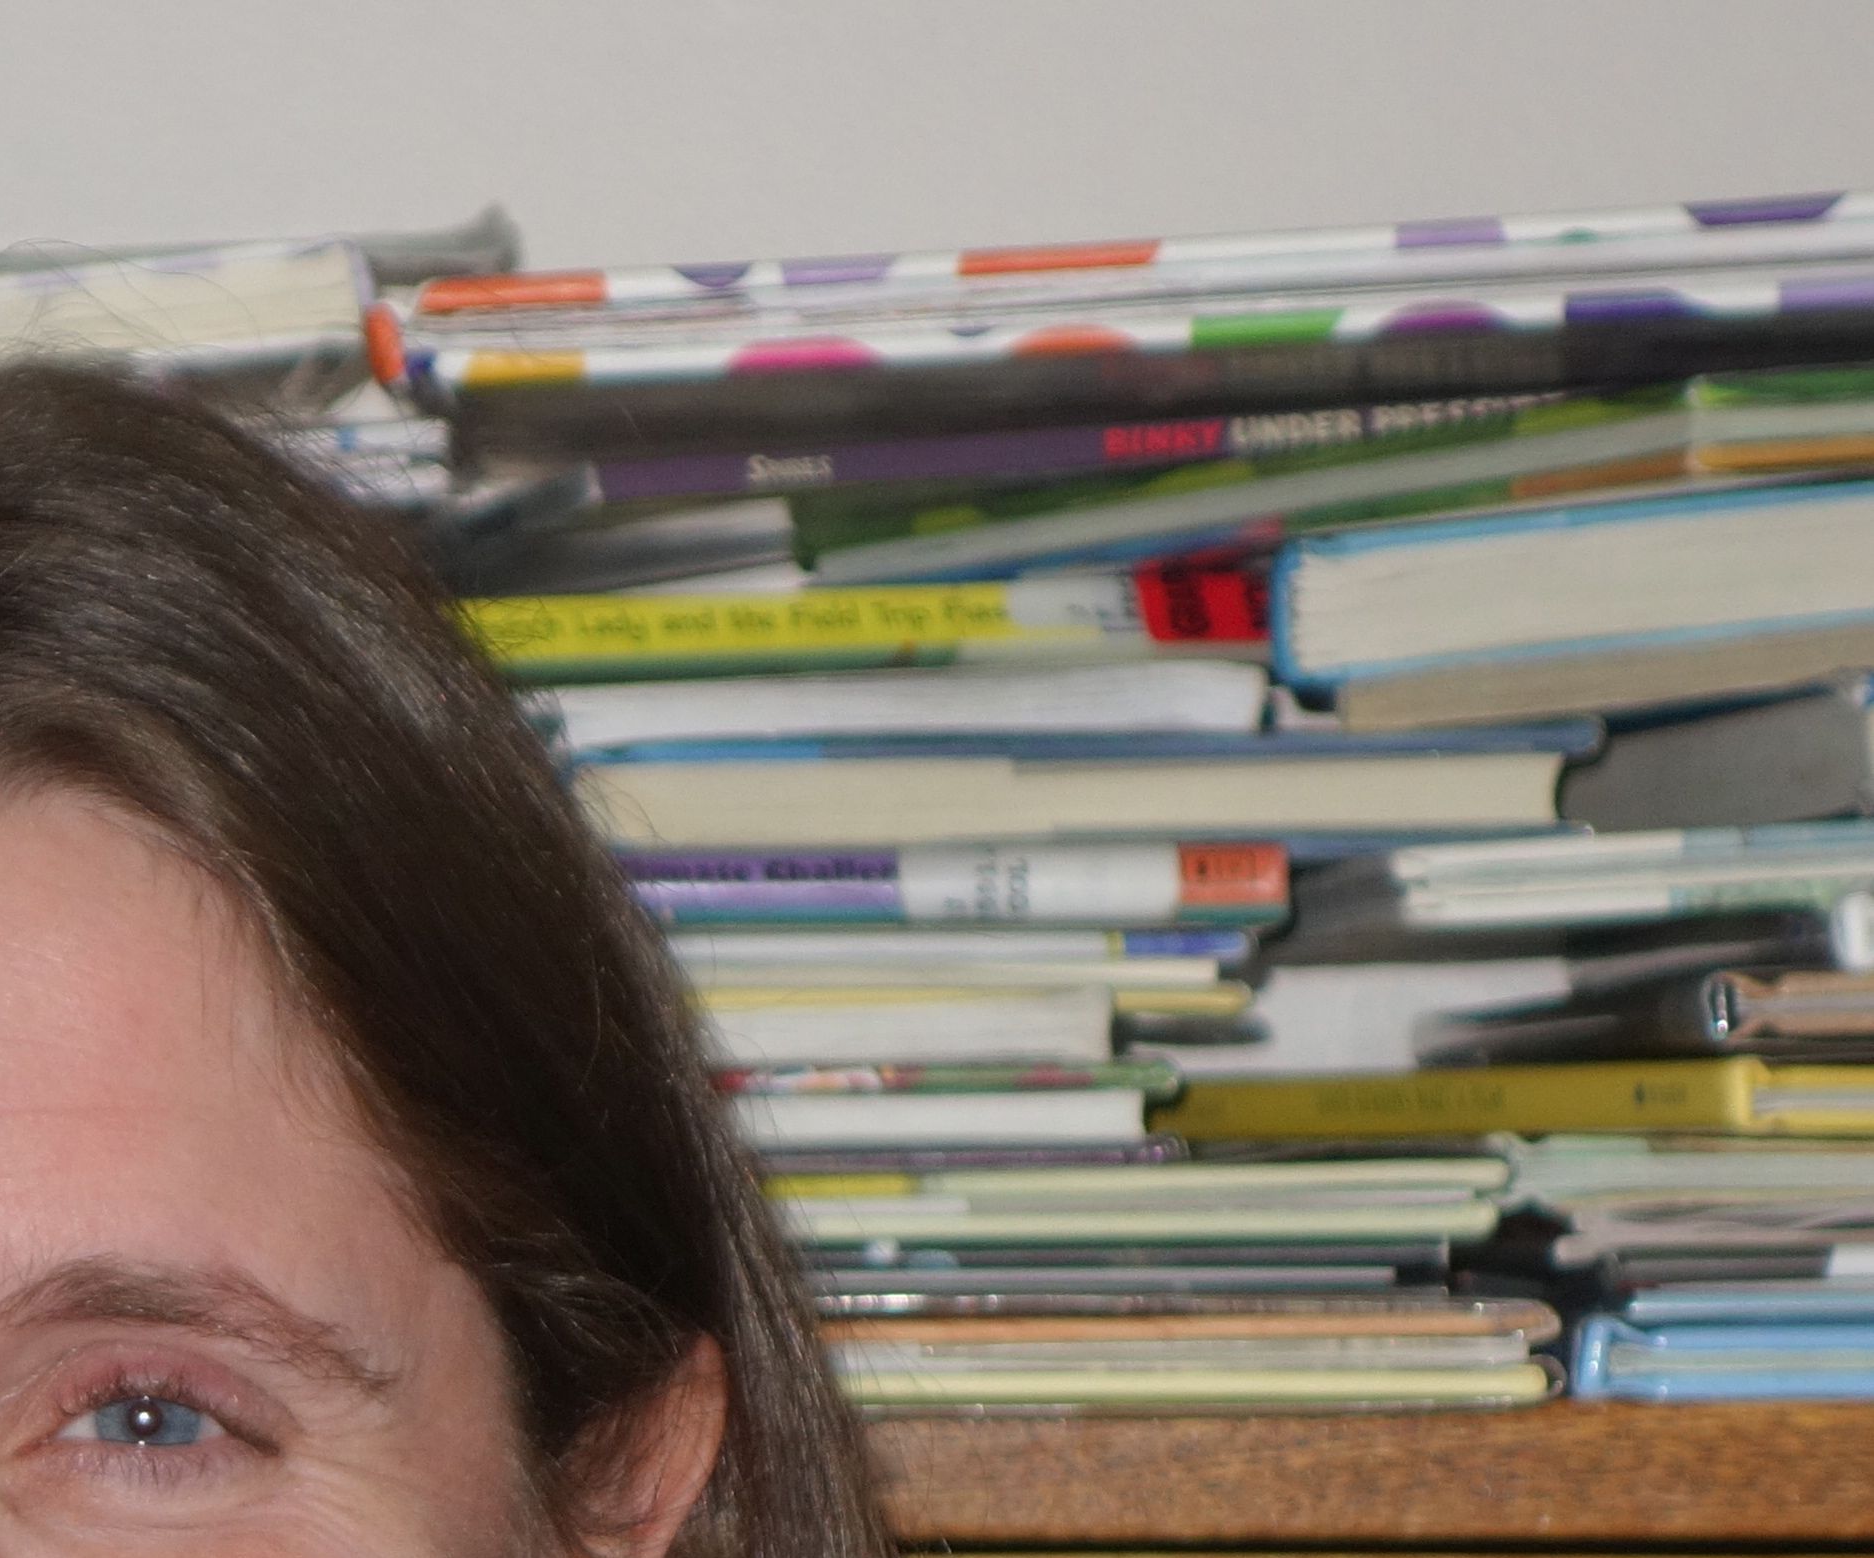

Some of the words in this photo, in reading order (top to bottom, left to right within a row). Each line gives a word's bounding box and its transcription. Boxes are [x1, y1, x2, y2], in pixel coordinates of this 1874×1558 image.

[1103, 420, 1223, 459] BINKY
[1230, 409, 1362, 452] UNDER
[662, 605, 718, 633] and
